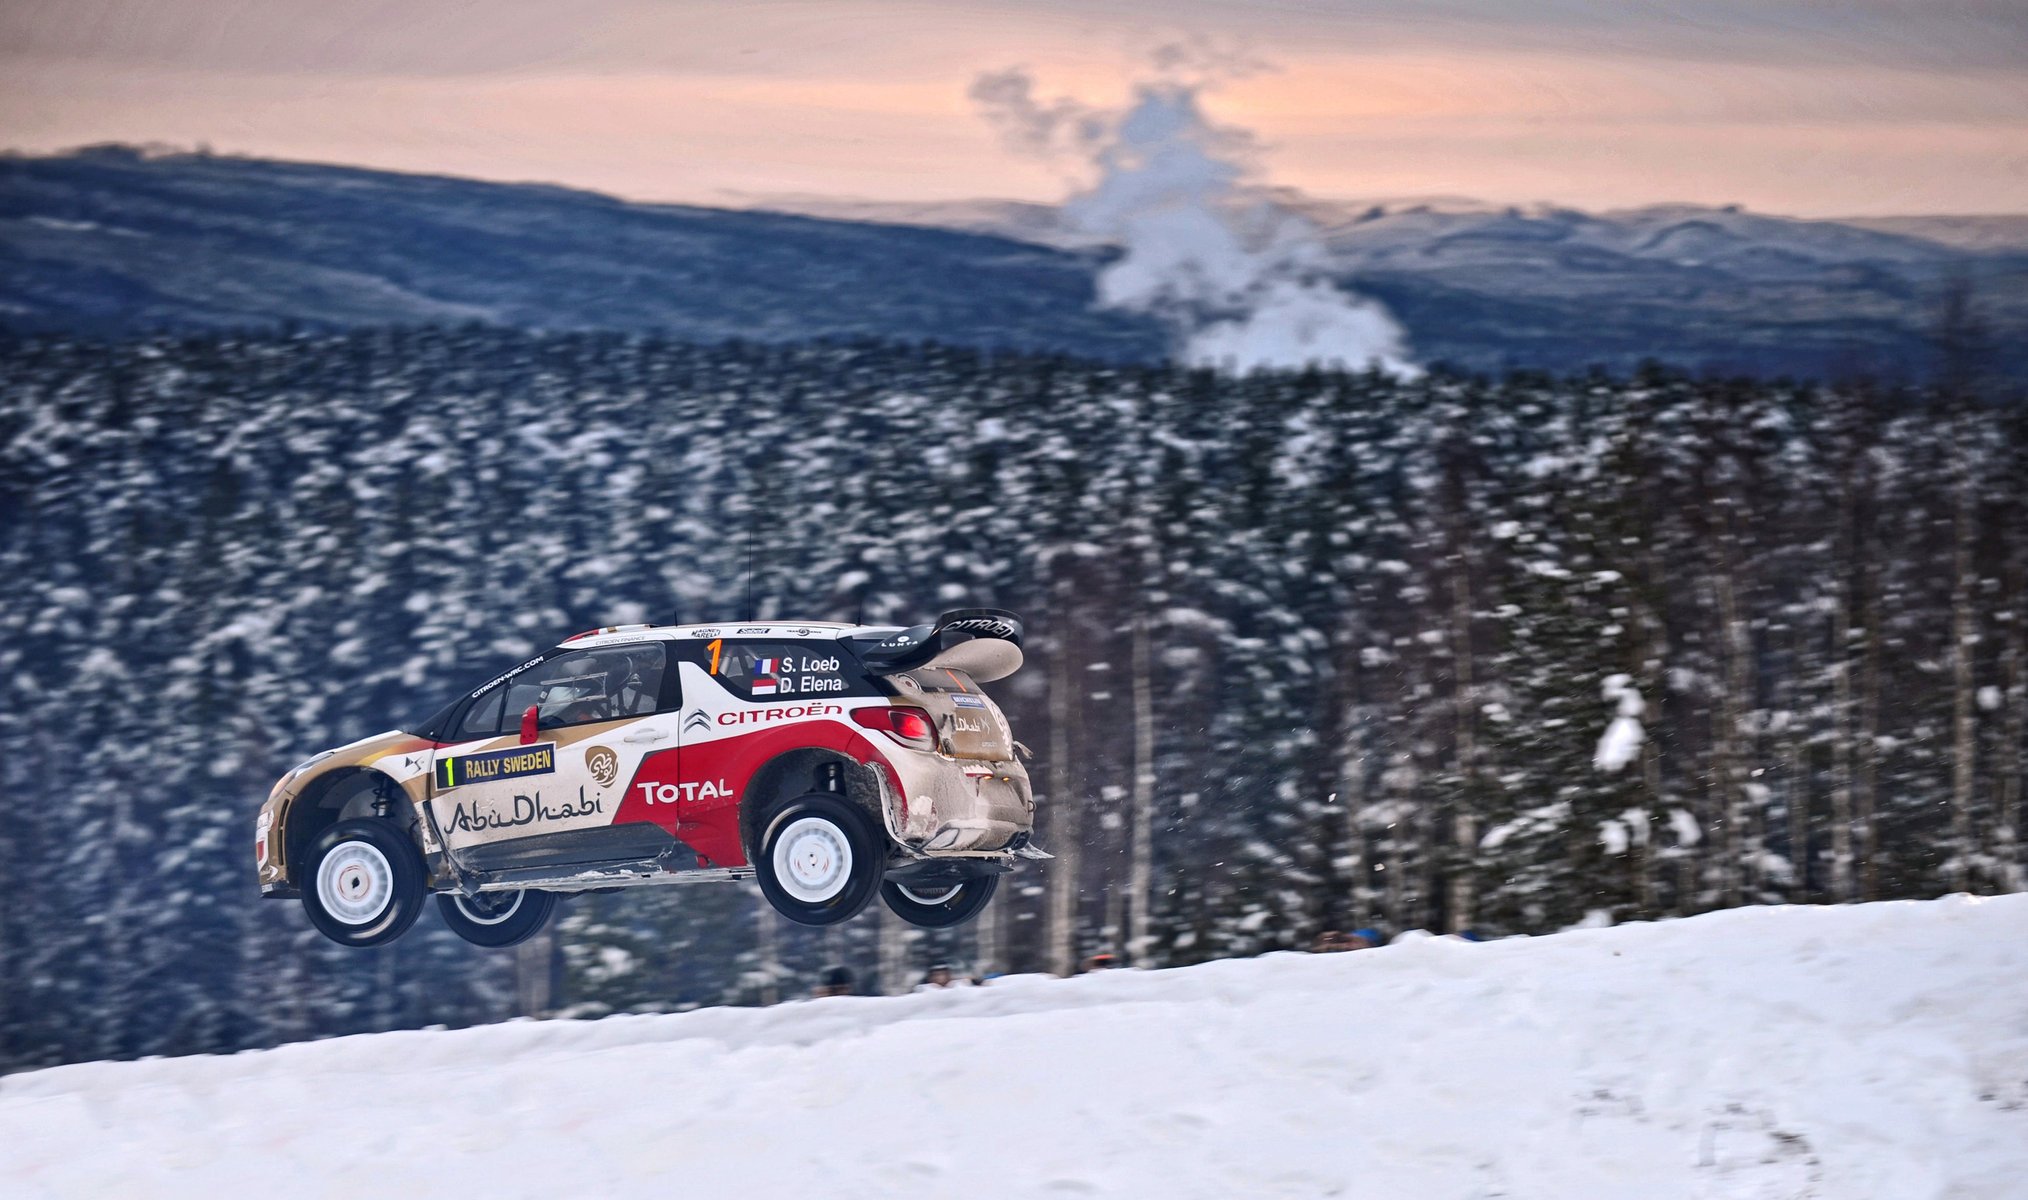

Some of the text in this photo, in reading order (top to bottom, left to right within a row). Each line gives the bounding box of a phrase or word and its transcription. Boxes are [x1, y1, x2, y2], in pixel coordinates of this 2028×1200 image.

[706, 639, 722, 676] 1
[781, 656, 840, 673] S. Loeb
[780, 676, 842, 694] D. Elena
[445, 749, 551, 787] 1 RALLY SWEDEN
[637, 778, 734, 805] TOTAL
